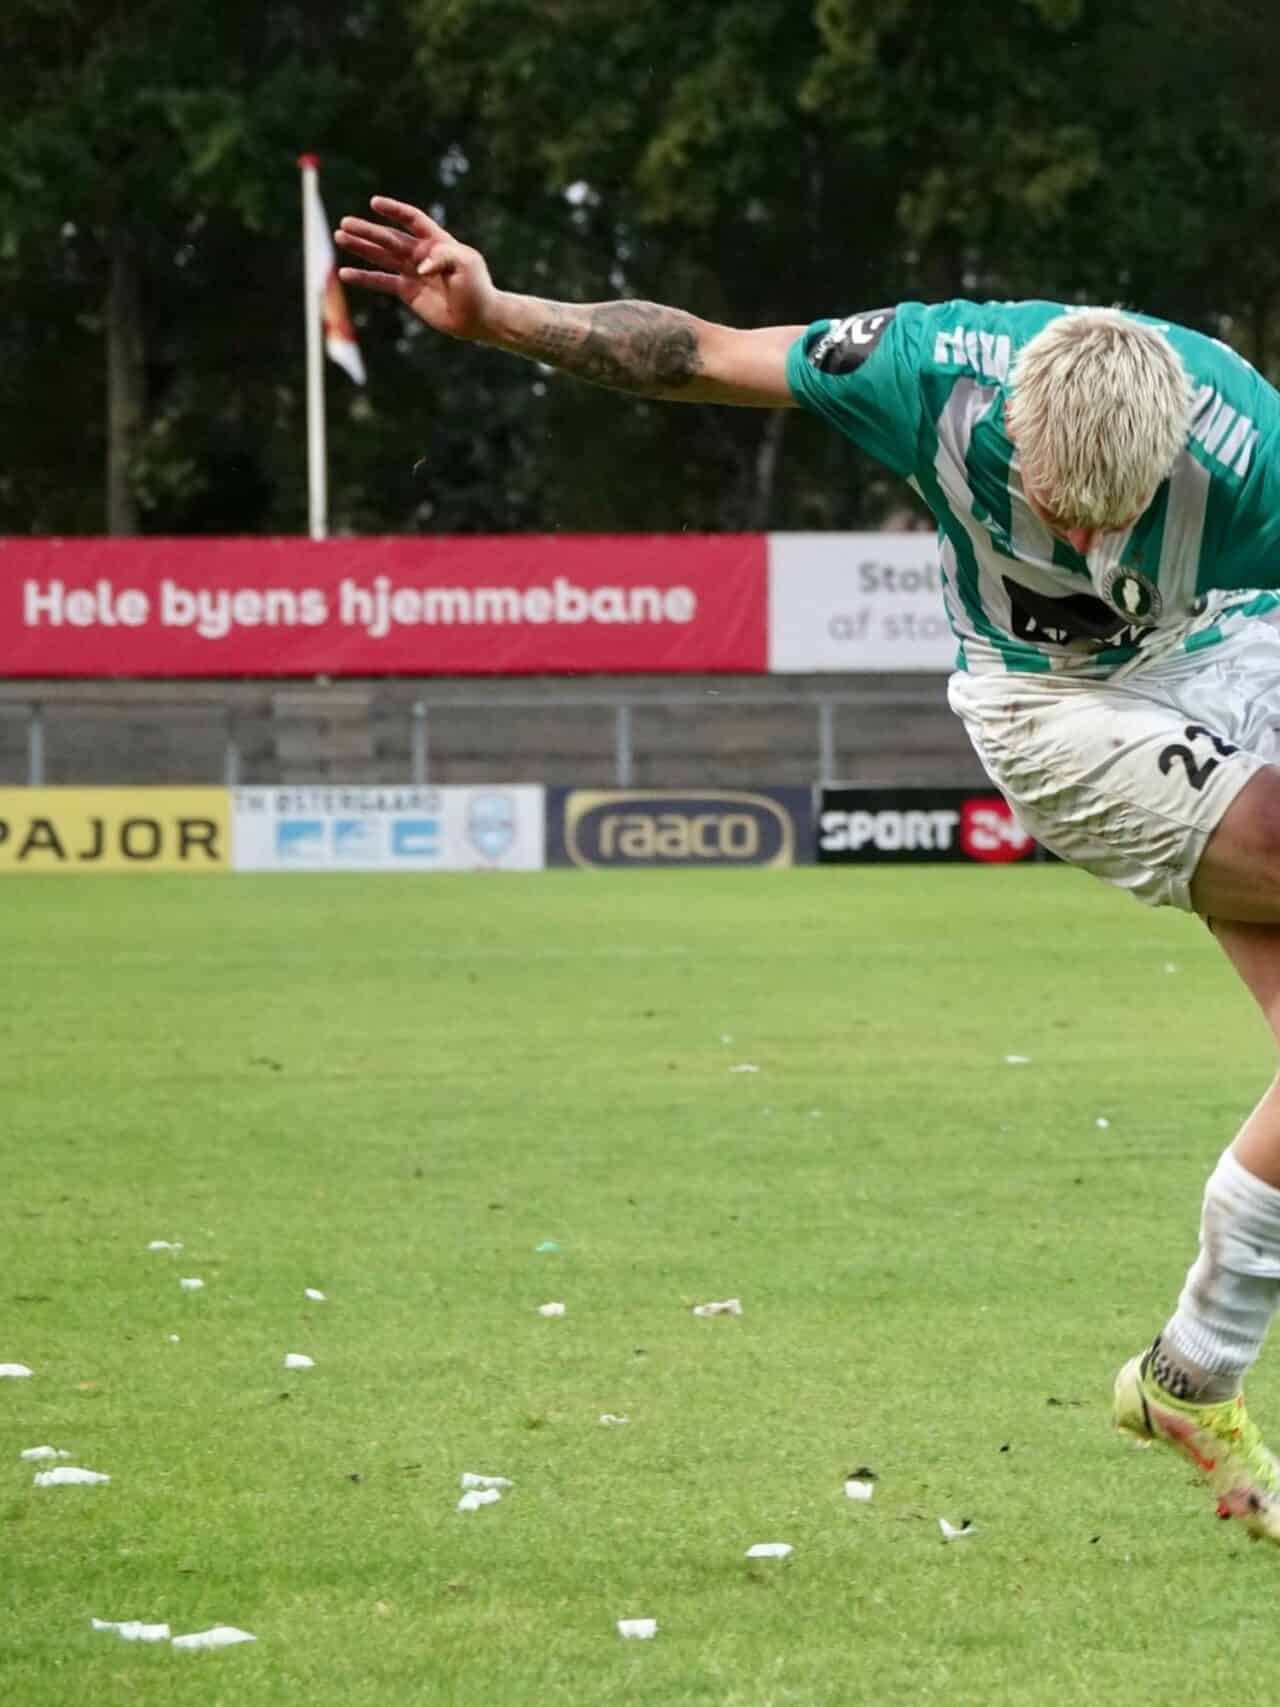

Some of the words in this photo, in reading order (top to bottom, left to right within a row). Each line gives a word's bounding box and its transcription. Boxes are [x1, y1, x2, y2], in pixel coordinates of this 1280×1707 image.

[857, 561, 936, 593] Stol
[23, 578, 150, 627] Hele
[160, 578, 328, 639] byens
[339, 575, 696, 638] hjemmebane
[881, 612, 949, 641] sto
[0, 816, 221, 861] AJOR
[600, 813, 758, 859] raaco
[819, 809, 959, 851] SPORT
[970, 809, 1027, 851] 24
